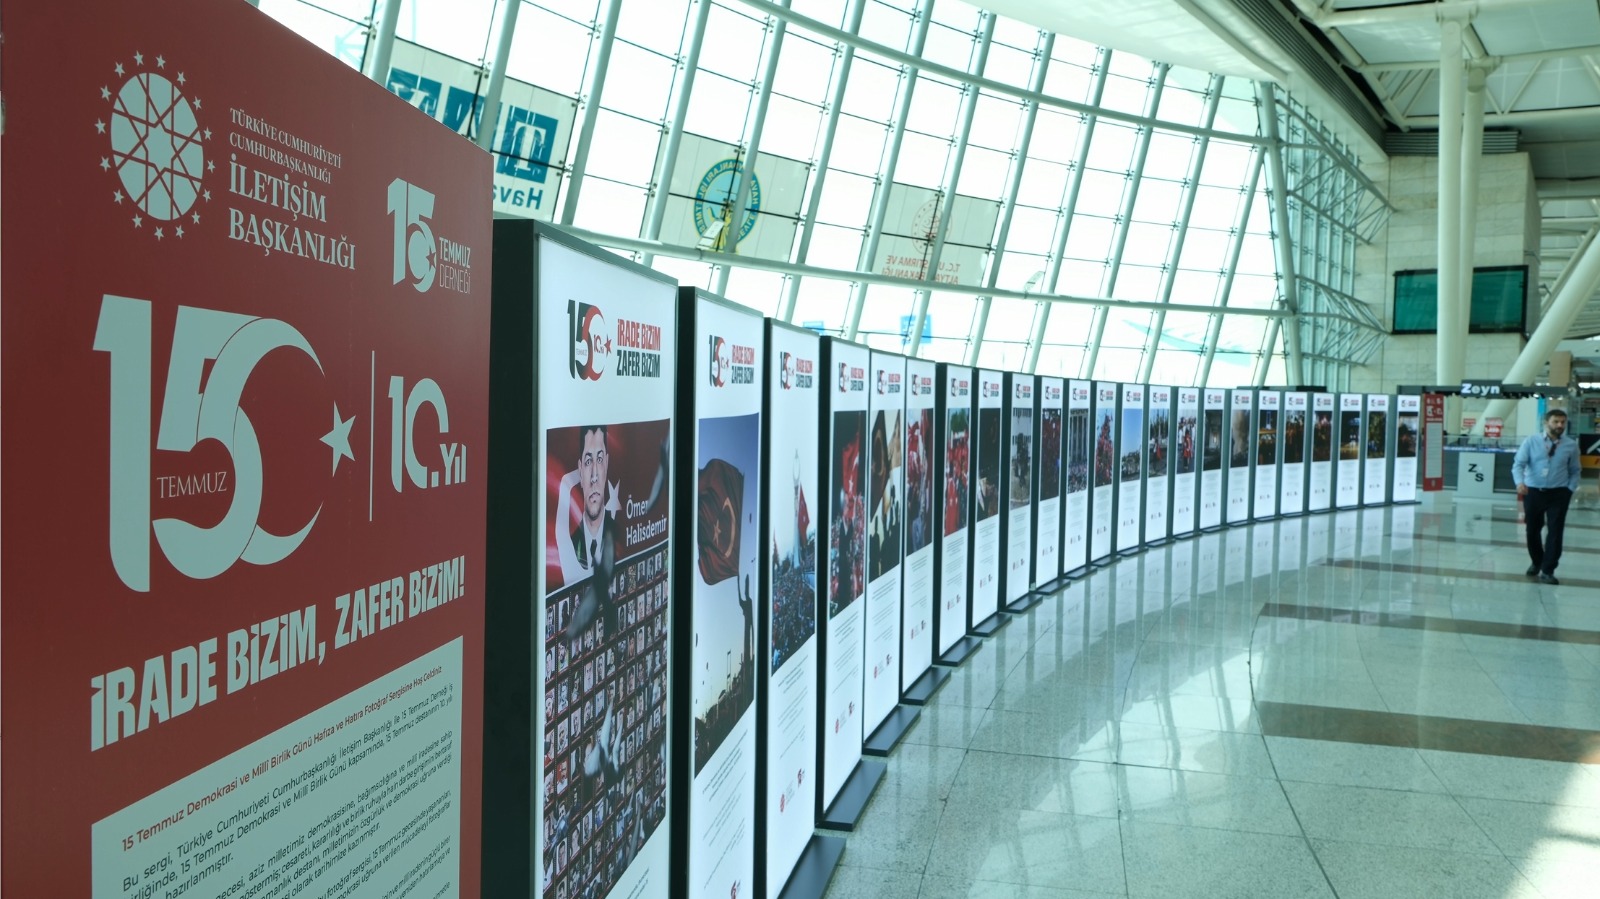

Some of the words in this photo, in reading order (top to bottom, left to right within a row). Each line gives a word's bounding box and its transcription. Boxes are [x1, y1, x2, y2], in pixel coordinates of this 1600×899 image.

[229, 131, 331, 185] CUMHURBAŞKANLIĞI
[230, 107, 277, 140] TÜRKİYE
[278, 131, 341, 169] CUMHURİYETİ
[229, 153, 327, 222] İLETİŞİM
[229, 207, 355, 270] BAŞKANLIĞI
[387, 177, 436, 293] 15
[439, 236, 471, 269] TEMMUZ
[439, 265, 471, 294] DERNEĞİ
[617, 318, 640, 348] İRADE
[641, 323, 661, 351] BİZİM
[617, 350, 640, 376] ZAFER
[641, 352, 660, 378] BİZİM
[1461, 383, 1500, 396] Zeyn
[93, 294, 263, 592] 15
[156, 471, 228, 498] TEMMUZ
[1468, 464, 1477, 473] Z
[1475, 473, 1484, 482] S
[626, 494, 648, 519] Ömer
[626, 514, 667, 547] Halisdemir
[91, 637, 218, 752] İRADE
[227, 605, 326, 695] BİZİM,
[335, 576, 404, 650] ZAFER
[409, 555, 465, 620] BİZİM!
[122, 834, 134, 852] 15
[136, 810, 184, 843] Temmuz
[187, 777, 238, 815] Demokrasi
[239, 773, 250, 786] ve
[270, 746, 291, 769] Birlik
[292, 736, 313, 756] Günü
[313, 722, 335, 744] Hafıza
[335, 718, 344, 731] ve
[344, 706, 364, 727] Hatıra
[364, 692, 389, 716] Fotoğraf
[388, 681, 413, 702] Sergisine
[413, 674, 423, 688] Hoş
[423, 666, 442, 682] Geldiniz
[123, 874, 139, 892] Bu
[144, 852, 173, 879] sergi,
[177, 830, 213, 858] Türkiye
[216, 792, 270, 833] Cumhuriyeti
[272, 753, 337, 799] Cumhurbaşkanlığı
[339, 739, 362, 759] İletişim
[363, 720, 391, 744] Başkanlığı
[401, 709, 407, 720] 15
[408, 698, 429, 716] Temmuz
[180, 858, 191, 875] 15
[193, 834, 235, 866] Temmuz
[237, 802, 281, 839] Demokrasi
[282, 798, 292, 809] ve
[310, 773, 328, 792] Birlik
[328, 760, 347, 779] Günü
[392, 720, 414, 739] Temmuz
[248, 864, 265, 882] aziz
[268, 835, 305, 868] milletimiz
[398, 764, 406, 774] ve
[342, 818, 350, 829] ve
[291, 874, 314, 897] olarak
[326, 869, 352, 899] fotoğraf
[377, 830, 402, 855] Temmuz
